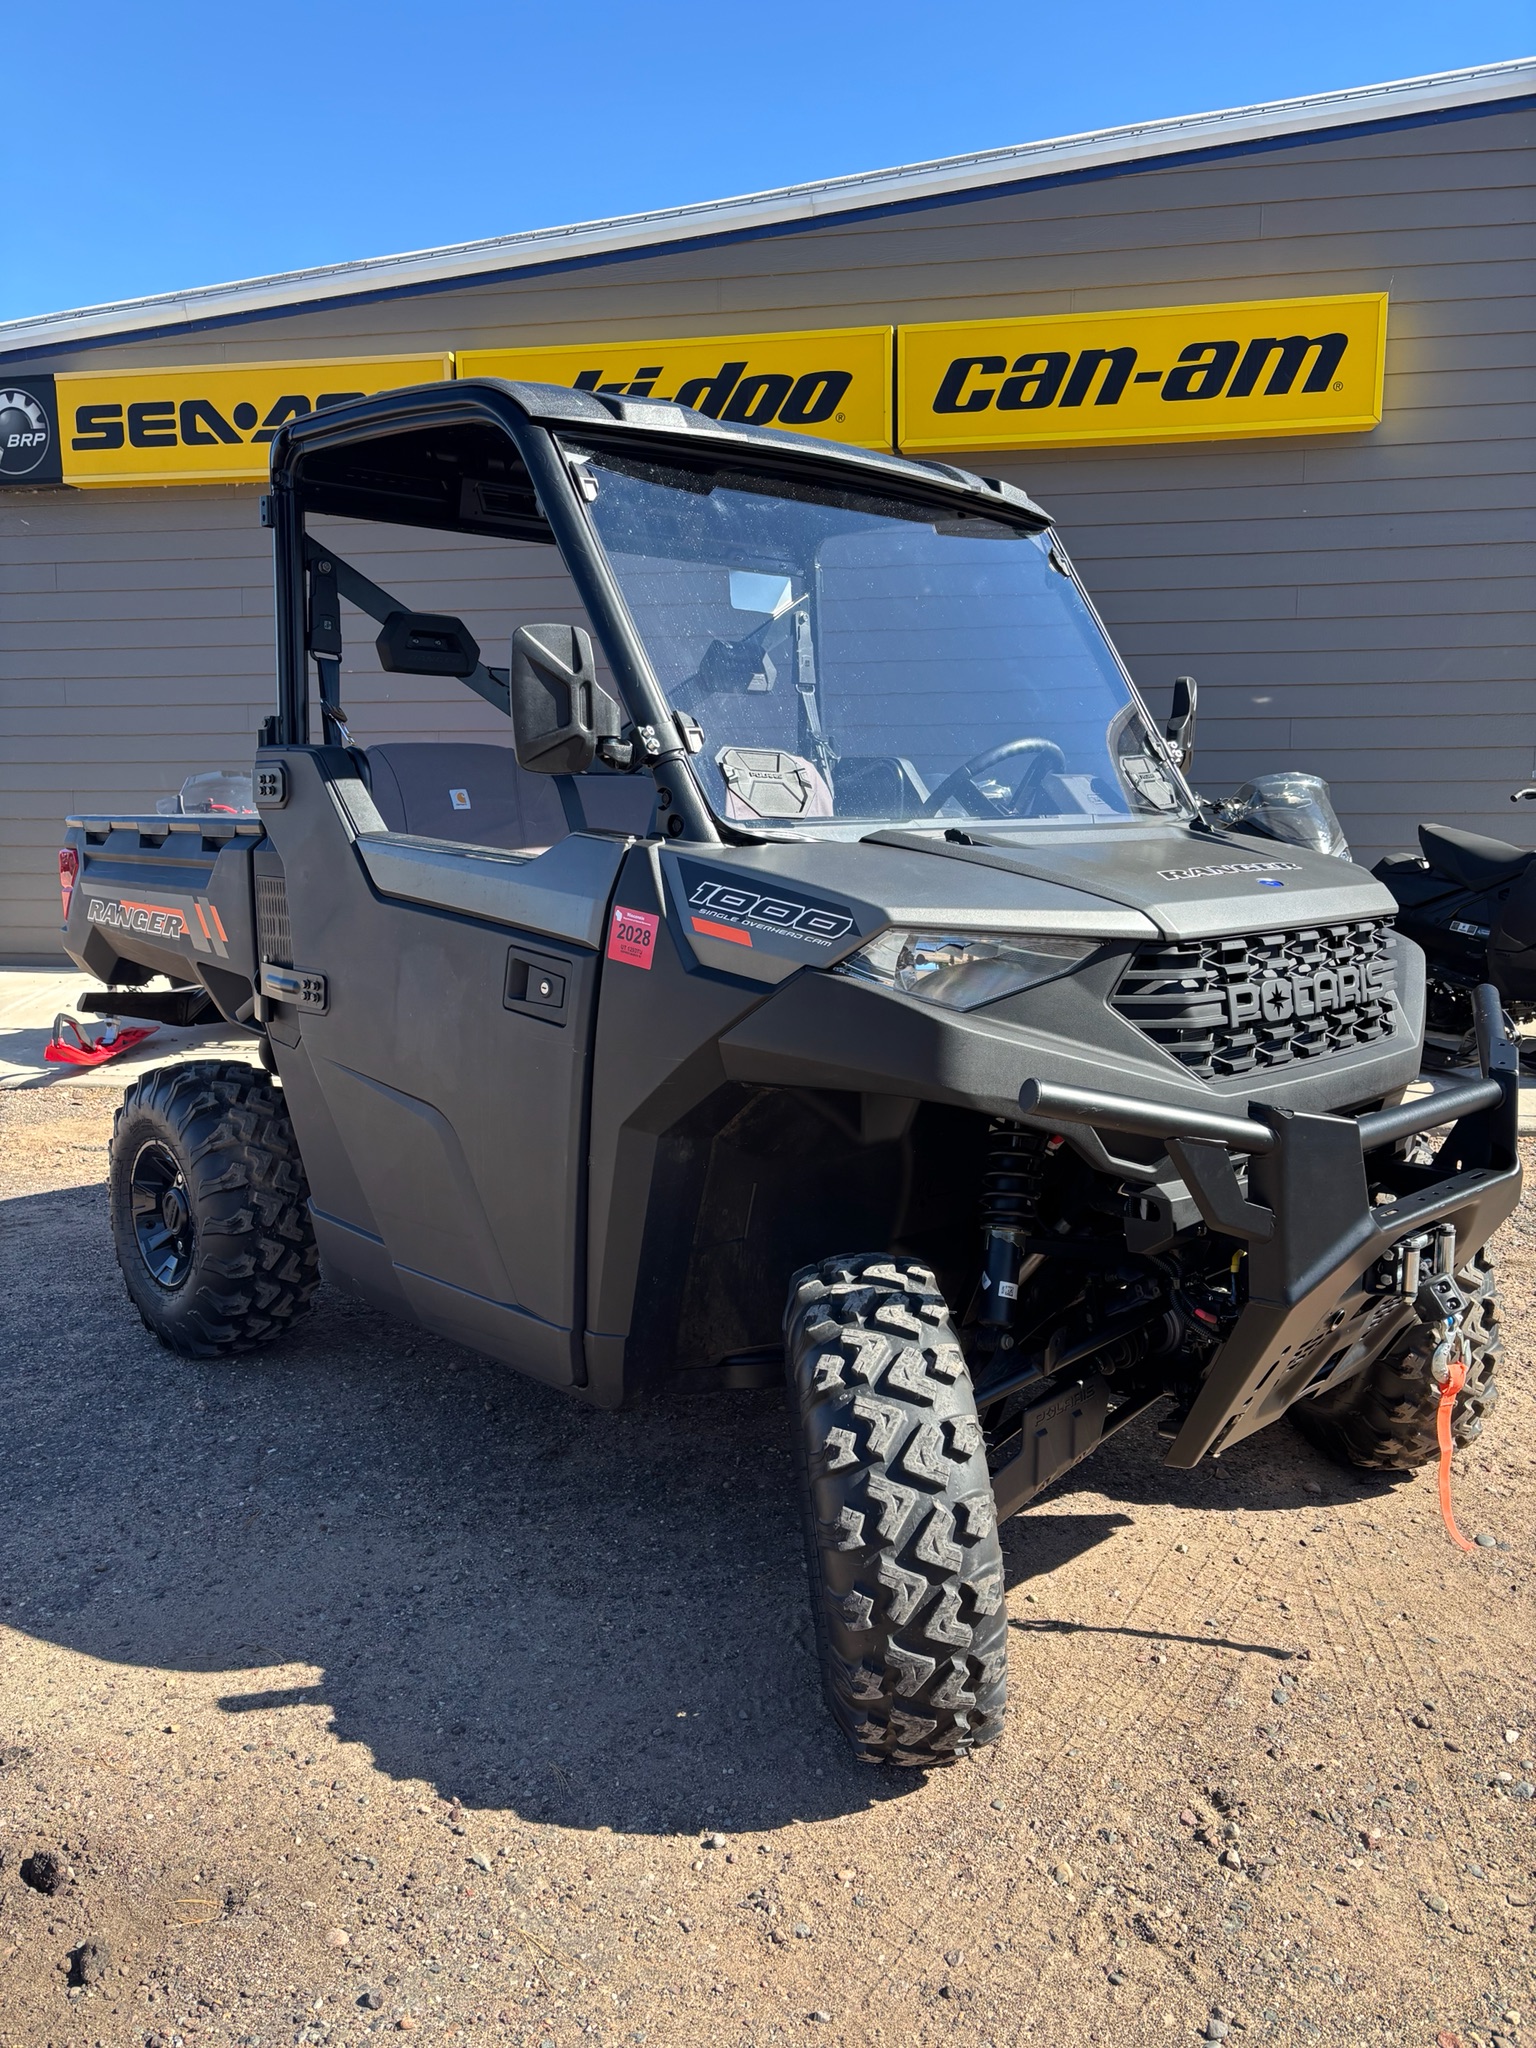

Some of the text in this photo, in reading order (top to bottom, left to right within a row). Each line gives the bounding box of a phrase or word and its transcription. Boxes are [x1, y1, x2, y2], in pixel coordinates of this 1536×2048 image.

[7, 433, 46, 448] BRP
[1157, 862, 1303, 881] RANGER
[87, 899, 184, 940] RANGER
[689, 881, 853, 939] 1000
[698, 908, 833, 947] SINGLE OVERHEAD CAM
[616, 923, 651, 947] 2028
[1227, 961, 1386, 1028] POLARIS
[1035, 1384, 1096, 1427] POLARIS
